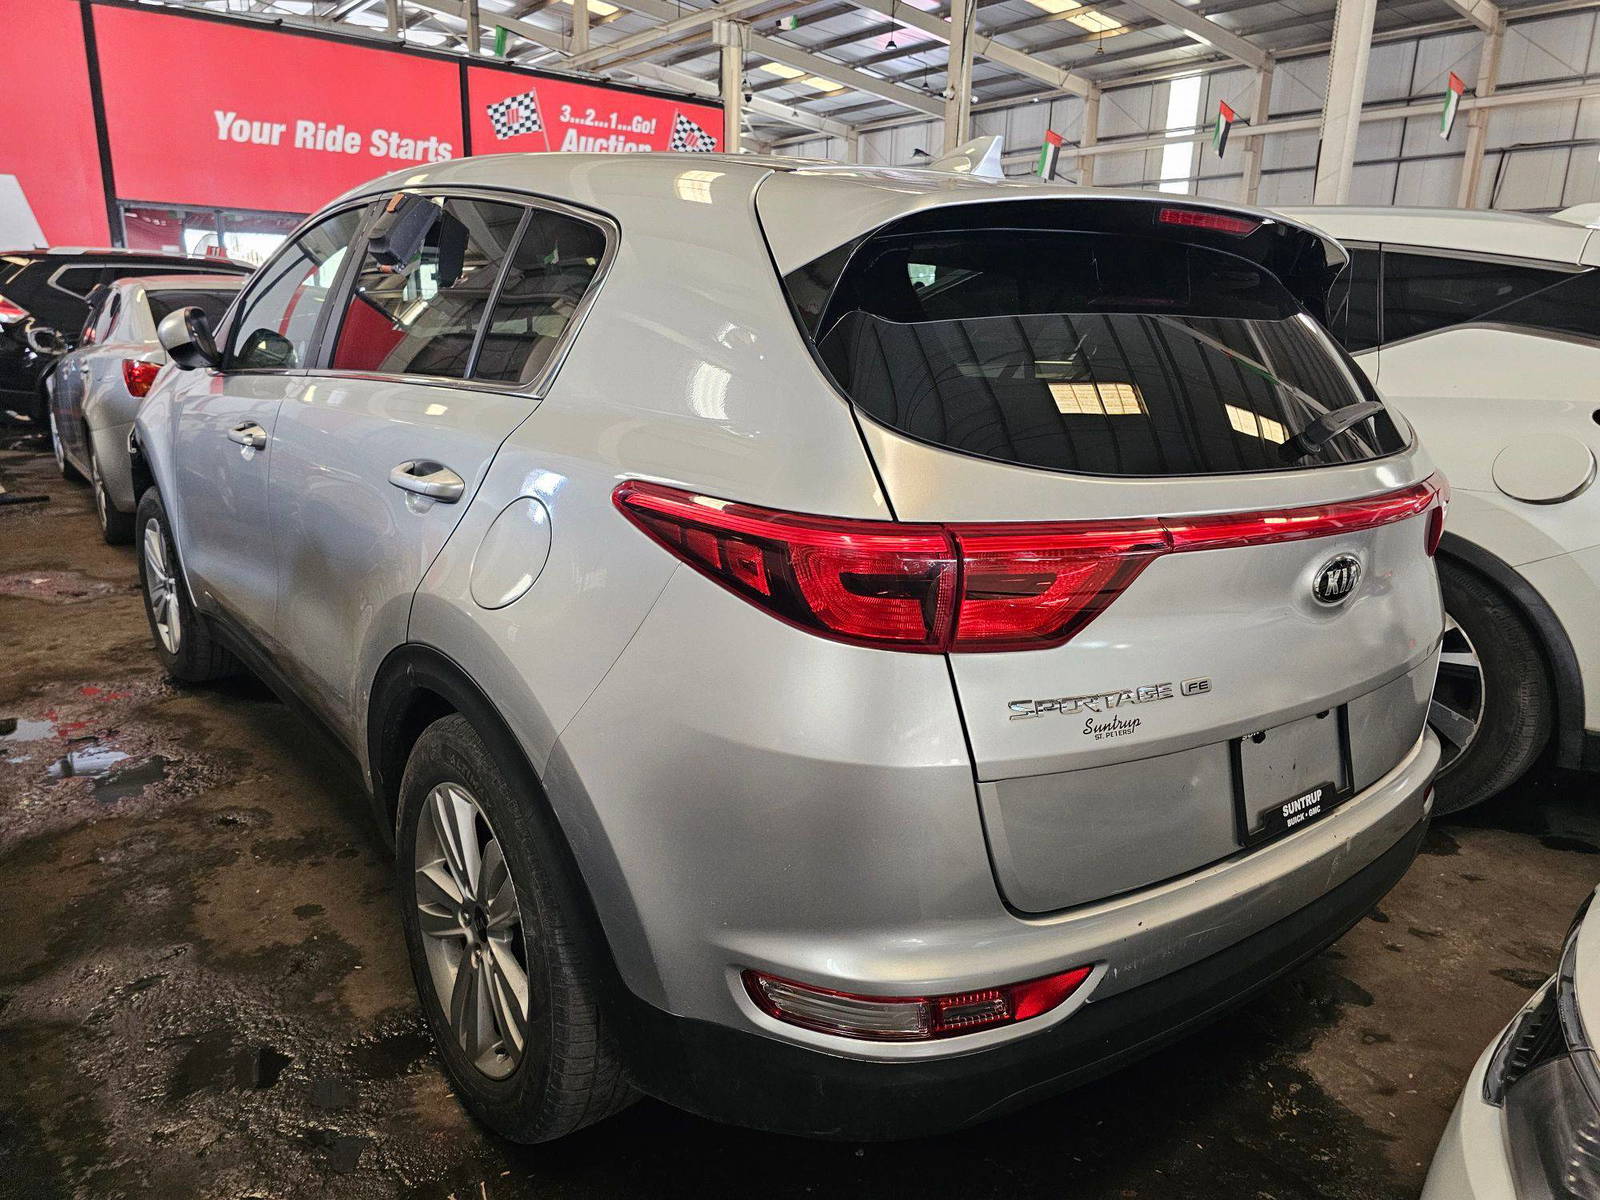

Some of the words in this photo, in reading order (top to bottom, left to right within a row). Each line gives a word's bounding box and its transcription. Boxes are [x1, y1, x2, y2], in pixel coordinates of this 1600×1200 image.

[213, 110, 287, 146] Your
[294, 119, 362, 155] Ride
[369, 129, 454, 162] Starts
[1324, 564, 1358, 597] KIA
[1007, 681, 1174, 721] SPORTAGE
[1187, 679, 1210, 693] FE
[1082, 713, 1142, 735] Suntrup
[1282, 789, 1322, 817] SUNTRUP
[1286, 812, 1305, 828] BUICK
[1308, 804, 1321, 817] GMC
